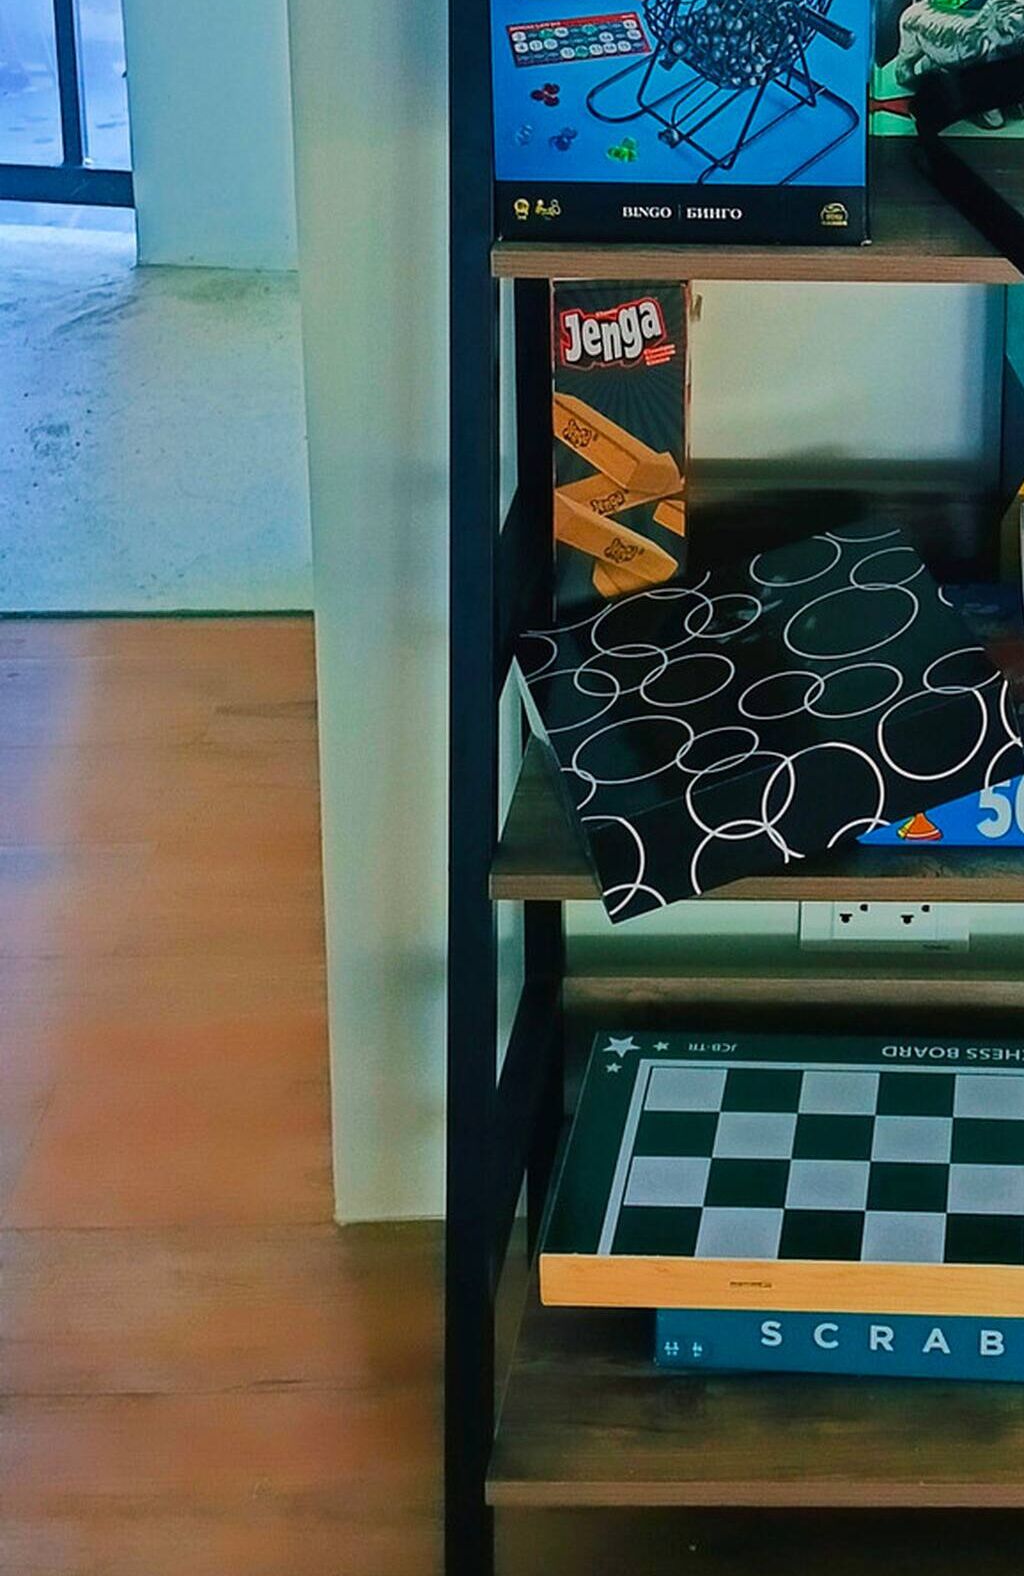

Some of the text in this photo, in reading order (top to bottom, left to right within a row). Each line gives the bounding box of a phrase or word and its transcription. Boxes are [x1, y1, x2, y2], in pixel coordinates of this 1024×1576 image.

[622, 206, 672, 219] BINGO
[686, 206, 742, 220] БИНГО
[564, 300, 662, 363] Jenga
[881, 1045, 960, 1061] BOARD
